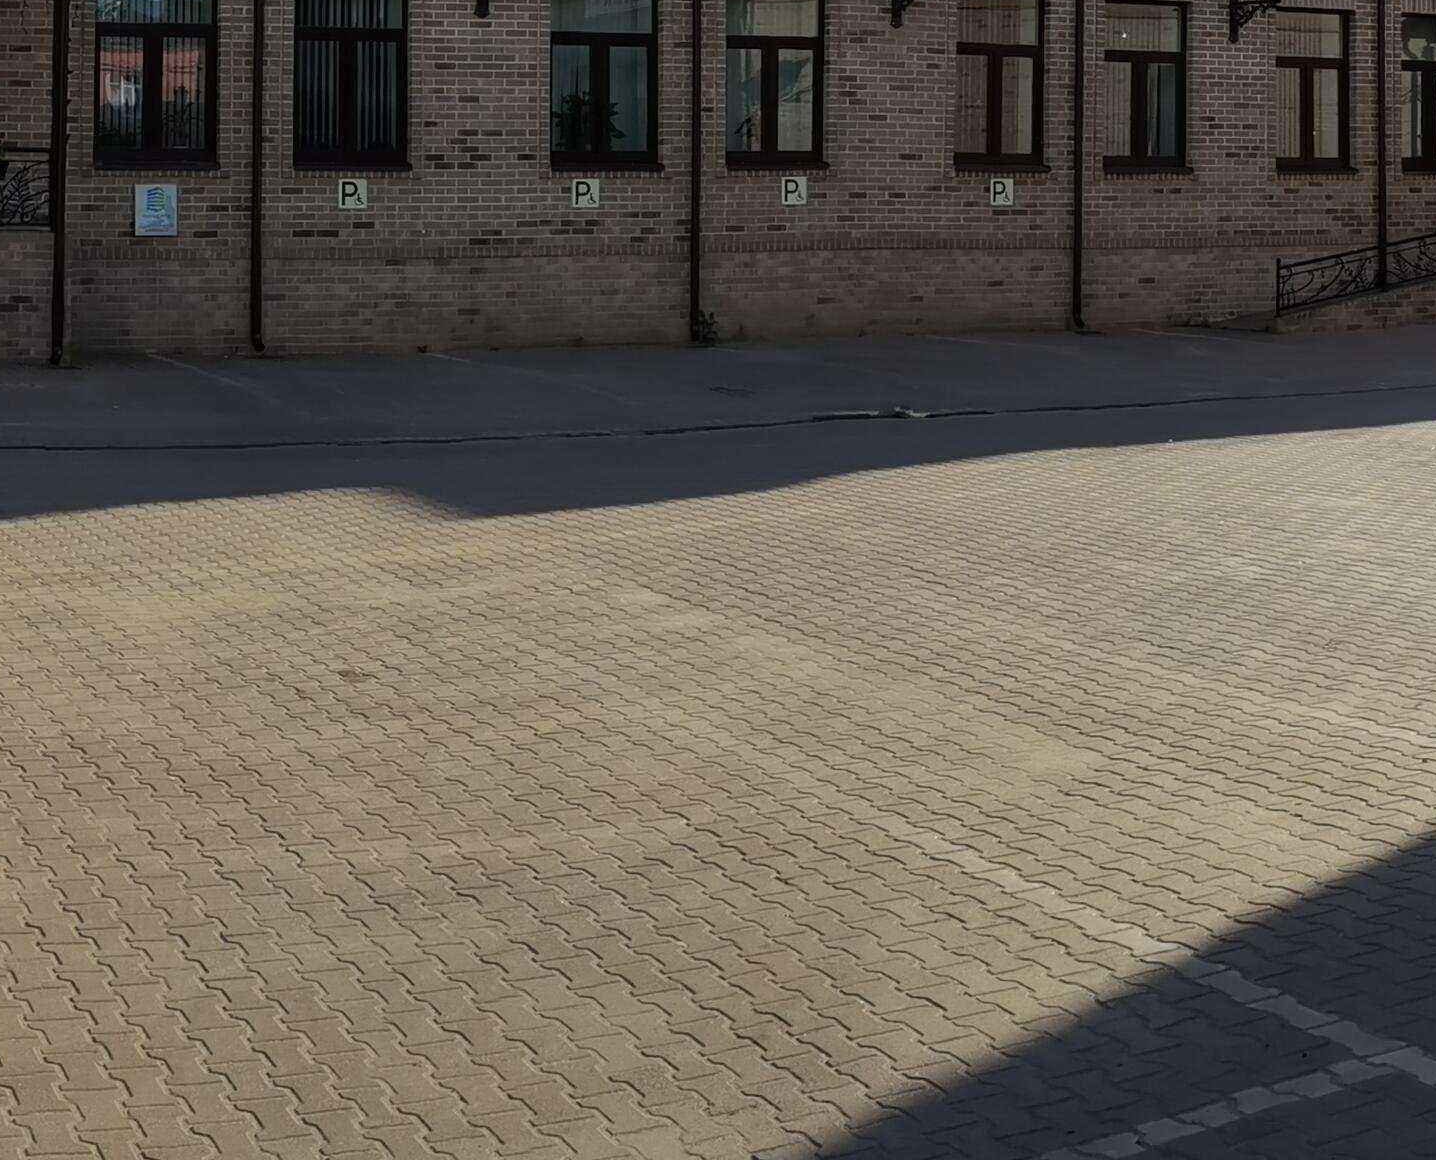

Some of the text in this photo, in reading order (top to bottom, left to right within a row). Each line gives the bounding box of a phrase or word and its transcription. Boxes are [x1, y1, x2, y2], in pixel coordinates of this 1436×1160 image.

[341, 181, 358, 206] P
[575, 181, 591, 205] P
[785, 179, 798, 202] P
[993, 181, 1006, 203] P
